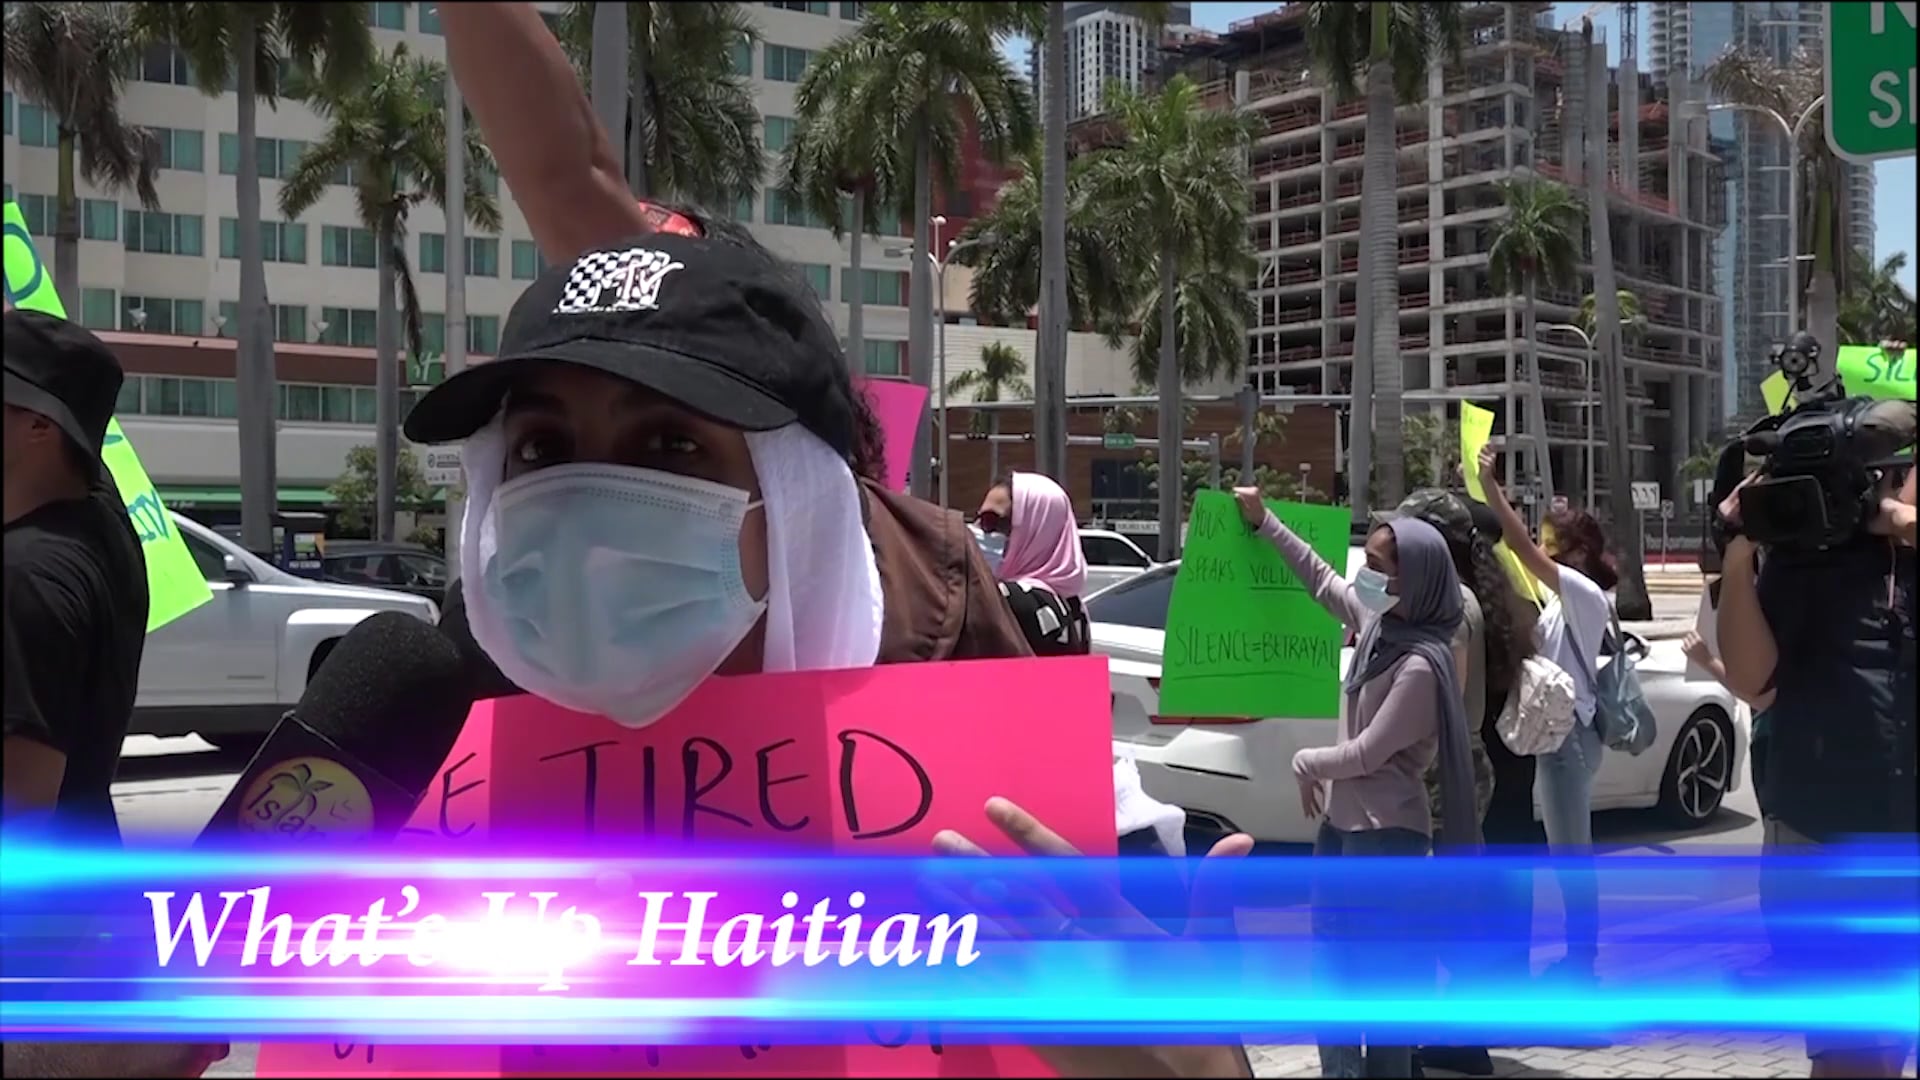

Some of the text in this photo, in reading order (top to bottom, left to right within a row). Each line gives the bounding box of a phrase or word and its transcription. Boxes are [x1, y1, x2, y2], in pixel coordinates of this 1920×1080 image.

[557, 248, 685, 311] MTV
[1193, 503, 1227, 540] YOUR
[1187, 555, 1235, 583] SPEAKS
[539, 729, 933, 841] TIRED
